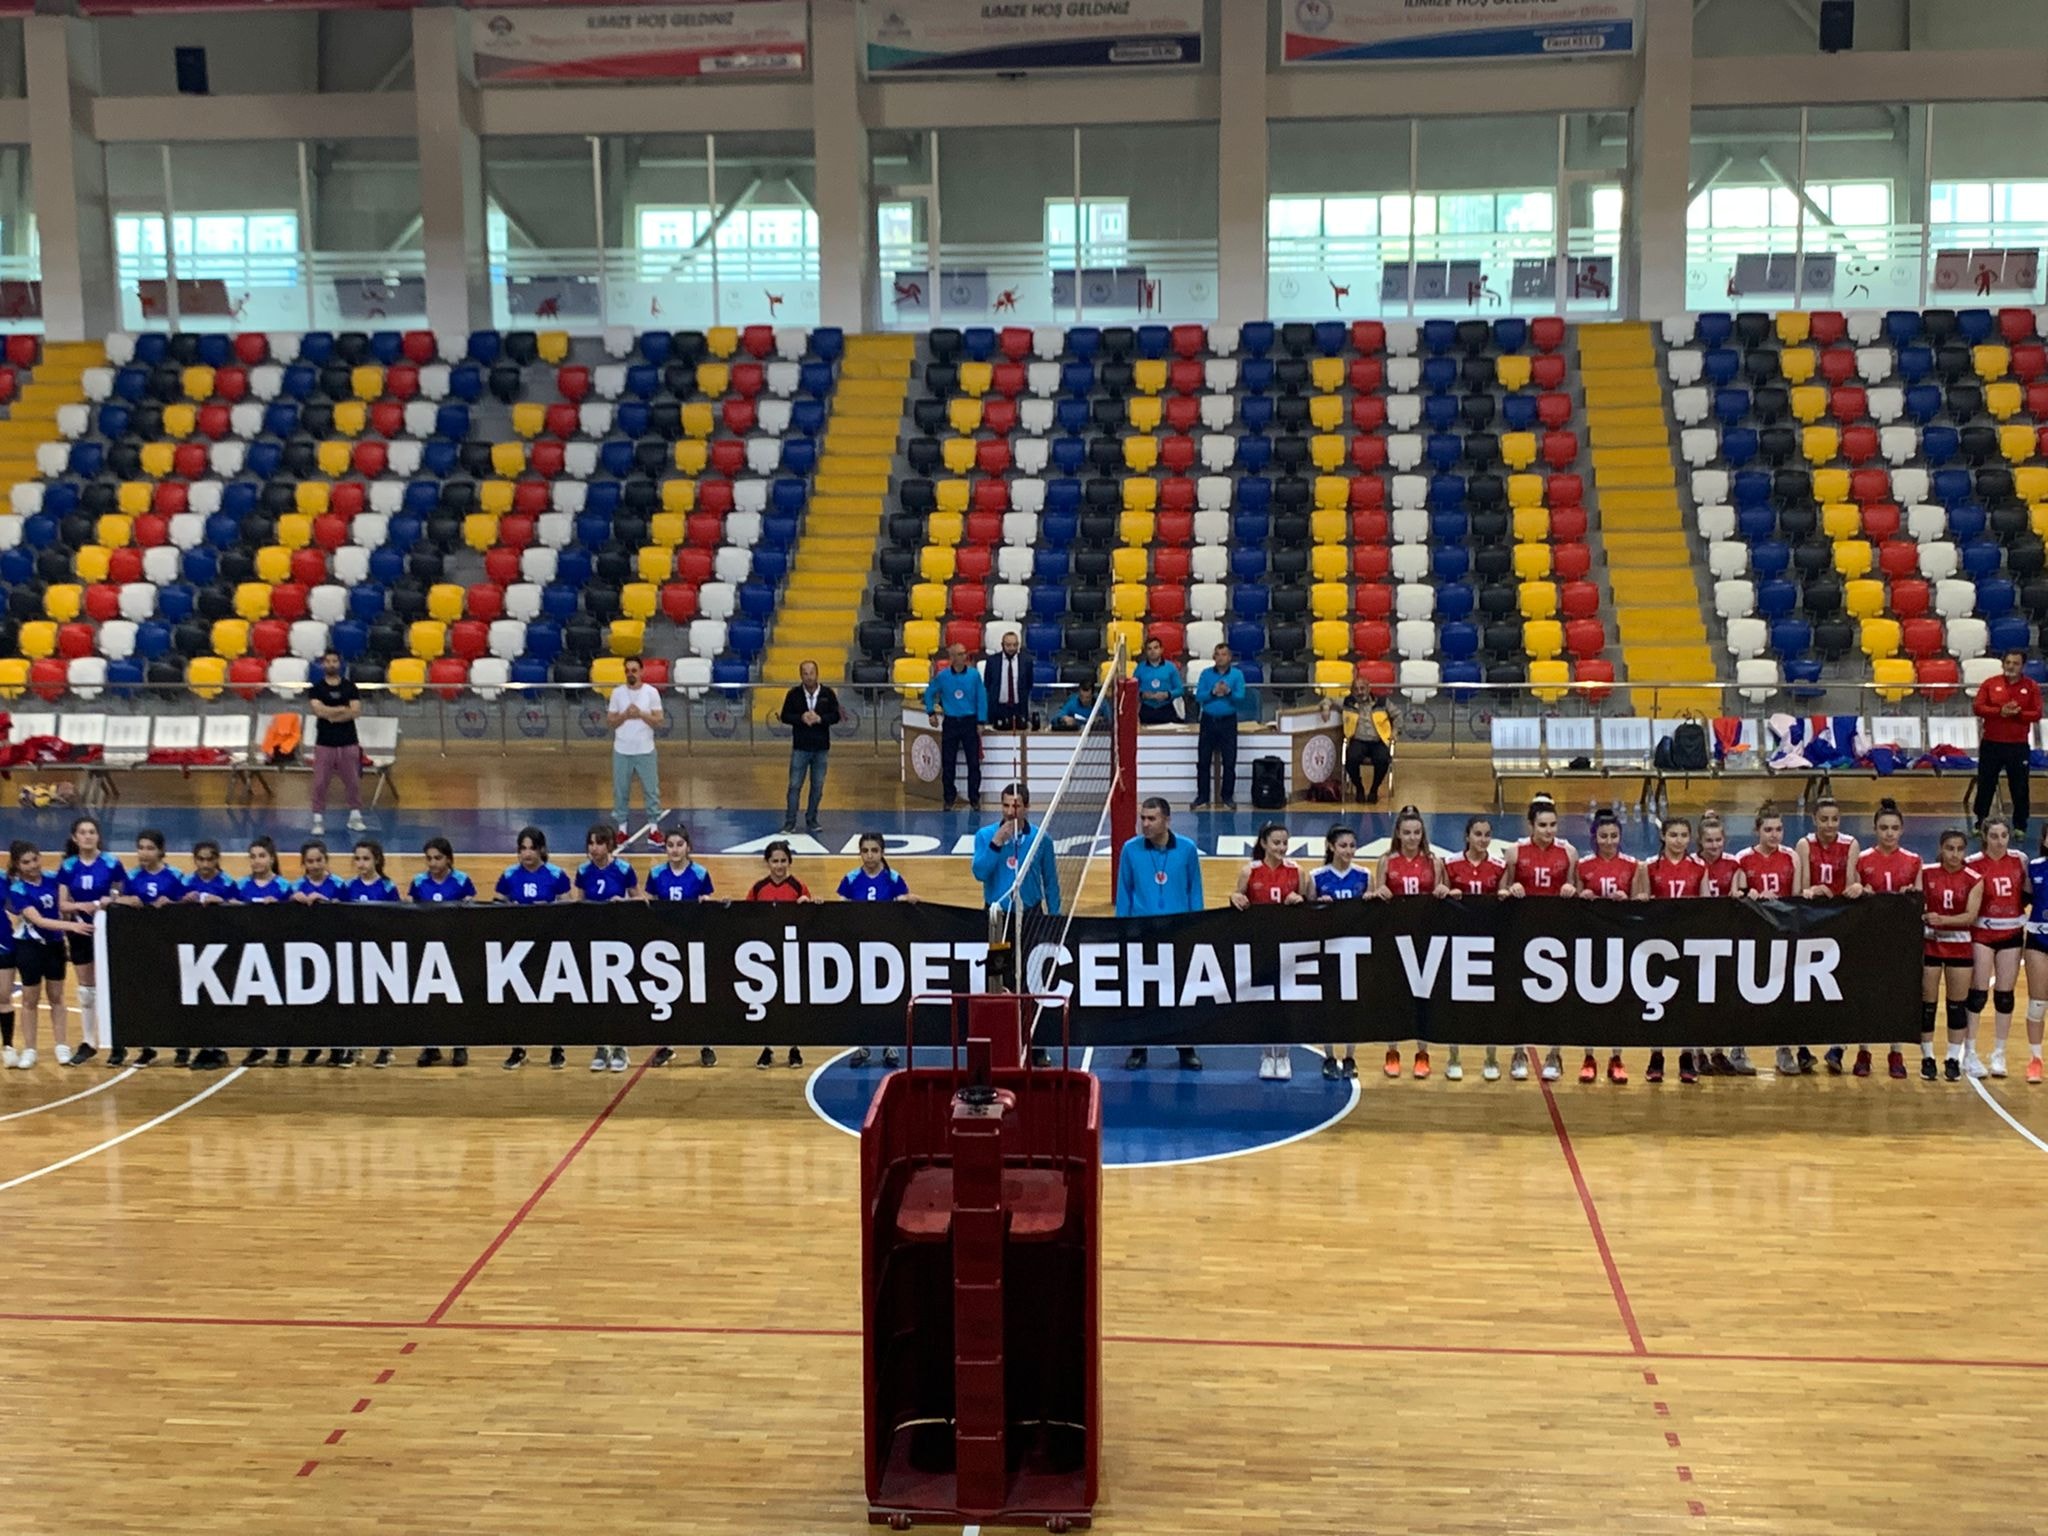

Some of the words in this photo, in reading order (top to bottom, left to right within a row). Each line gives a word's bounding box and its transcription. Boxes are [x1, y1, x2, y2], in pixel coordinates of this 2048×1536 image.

[1402, 877, 1419, 895] 18
[1534, 867, 1551, 888] 15
[1761, 873, 1779, 893] 13
[1884, 872, 1892, 891] 1
[147, 882, 158, 897] 5
[523, 883, 538, 897] 16
[597, 879, 606, 895] 7
[669, 886, 682, 900] 15
[867, 886, 877, 901] 2
[1270, 887, 1281, 904] 9
[1600, 877, 1617, 897] 16
[1669, 880, 1686, 898] 17
[1993, 877, 2012, 897] 12
[1943, 889, 1954, 909] 8
[178, 942, 463, 1005] KADINA
[485, 940, 706, 1021] KARŞI
[734, 926, 989, 1020] ŞİDDET
[1027, 936, 1372, 1007] CEHALET
[1396, 935, 1495, 1001] VE
[1522, 936, 1843, 1021] SUÇTUR
